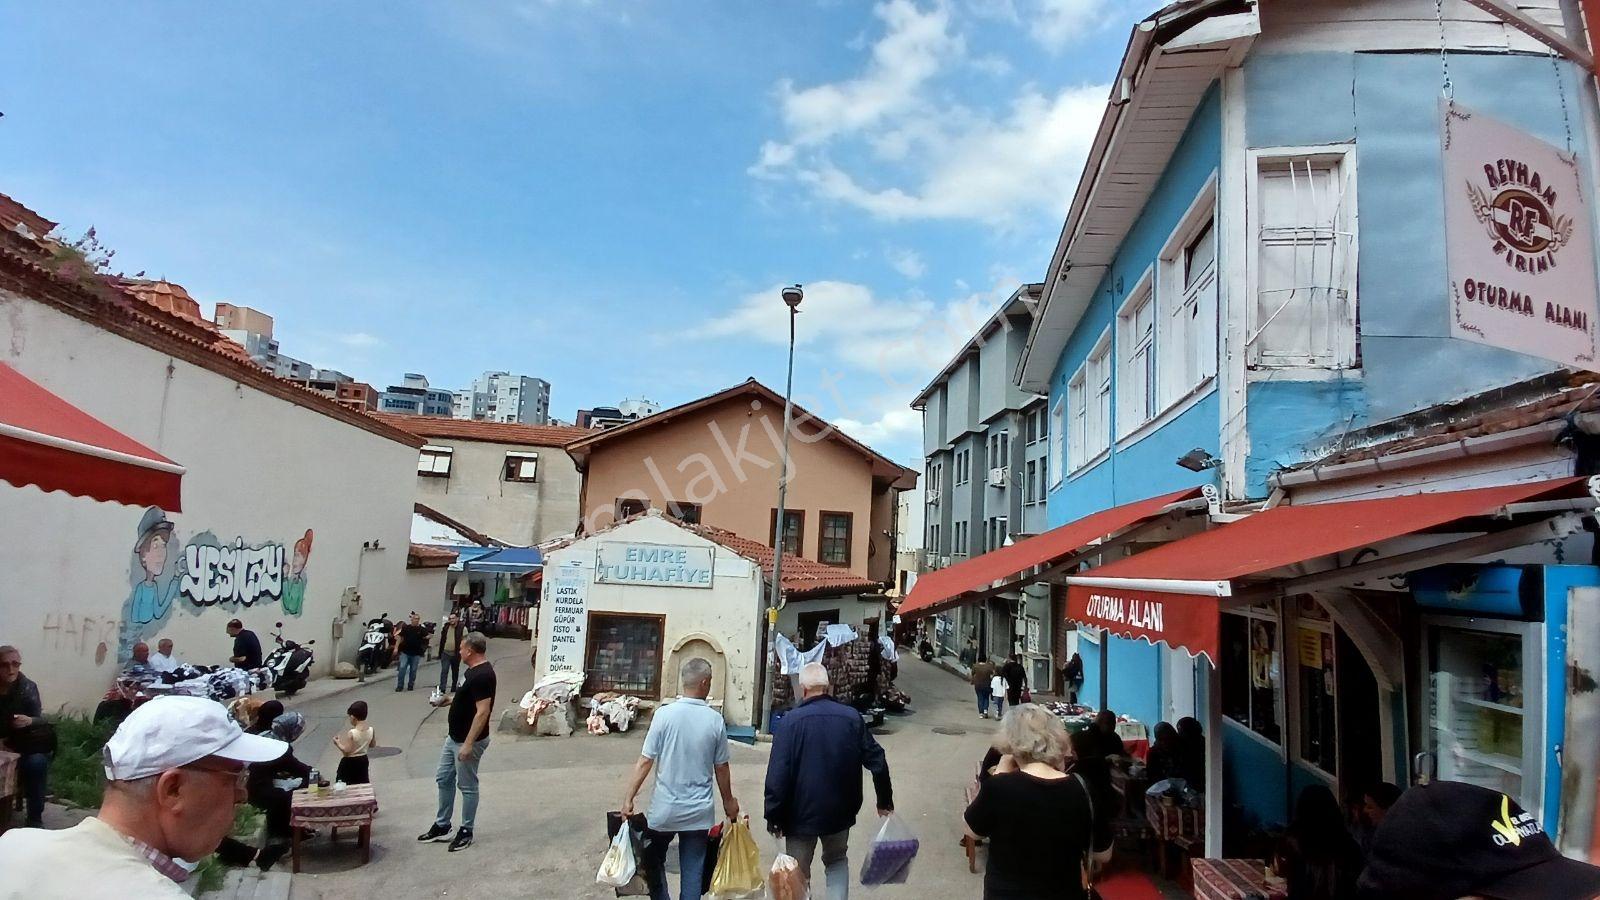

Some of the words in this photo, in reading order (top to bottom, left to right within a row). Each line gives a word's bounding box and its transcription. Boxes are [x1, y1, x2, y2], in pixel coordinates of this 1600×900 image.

[1509, 199, 1539, 244] RF
[1464, 278, 1534, 317] OTURMA
[1545, 301, 1588, 332] ALANI
[625, 547, 687, 564] EMRE
[602, 564, 710, 584] TUHAFİYE
[555, 597, 584, 605] KURDELA
[555, 606, 584, 615] FERMUAR
[1086, 594, 1125, 624] OTURMA
[1127, 599, 1164, 633] ALANI
[552, 635, 576, 643] DANTEL
